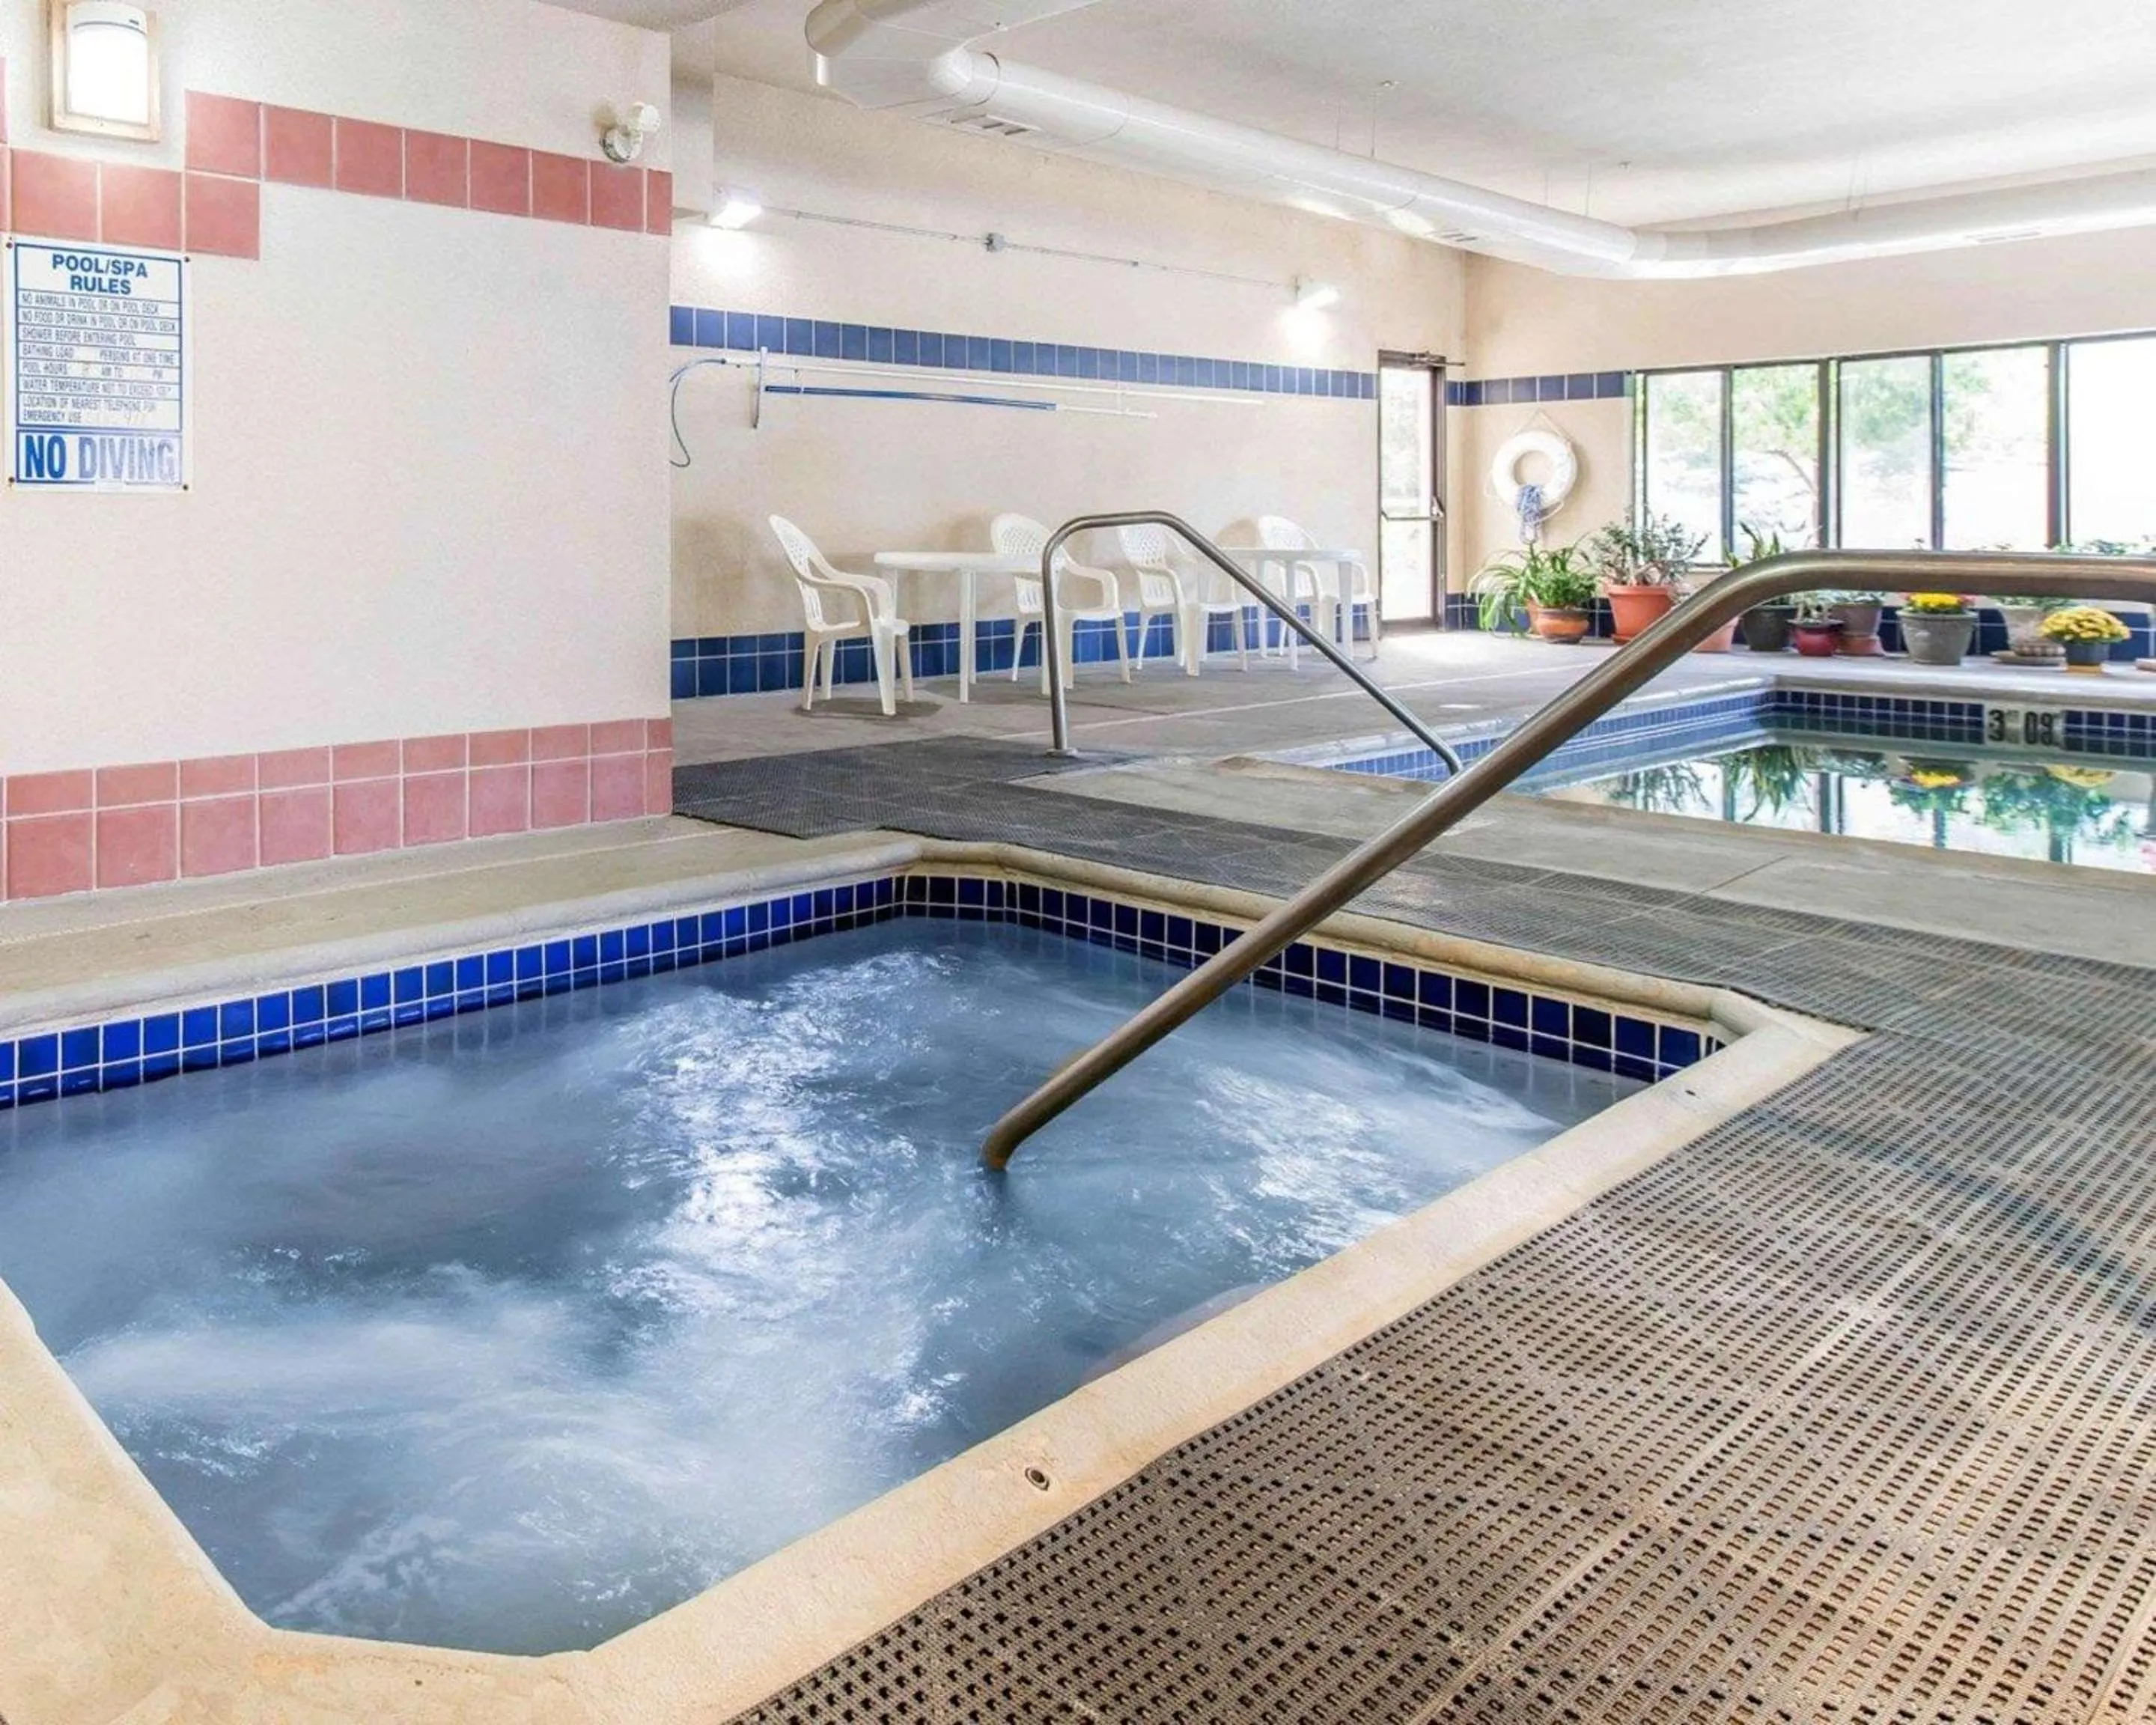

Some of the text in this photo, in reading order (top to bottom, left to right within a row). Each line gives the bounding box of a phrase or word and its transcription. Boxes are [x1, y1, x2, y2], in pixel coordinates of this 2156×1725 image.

[52, 254, 148, 279] POOL/SPA
[70, 276, 132, 295] RULES
[22, 293, 33, 305] NO
[35, 294, 65, 307] ANIMALS
[78, 297, 97, 310] POOL
[123, 300, 140, 314] POOL
[22, 310, 32, 322] NO
[34, 311, 53, 323] FOOD
[67, 313, 88, 326] DRINK
[22, 327, 52, 341] SHOWER
[55, 329, 81, 343] BEFORE
[83, 331, 117, 344] ENTERING
[22, 344, 54, 357] BATHING
[55, 346, 74, 359] LOAD
[22, 361, 41, 374] POOL
[43, 362, 67, 375] HOURS
[23, 379, 47, 391] WATER
[50, 380, 100, 394] TEMPERATURE
[22, 395, 57, 408] LOCATION
[25, 434, 176, 484] NO DIVING
